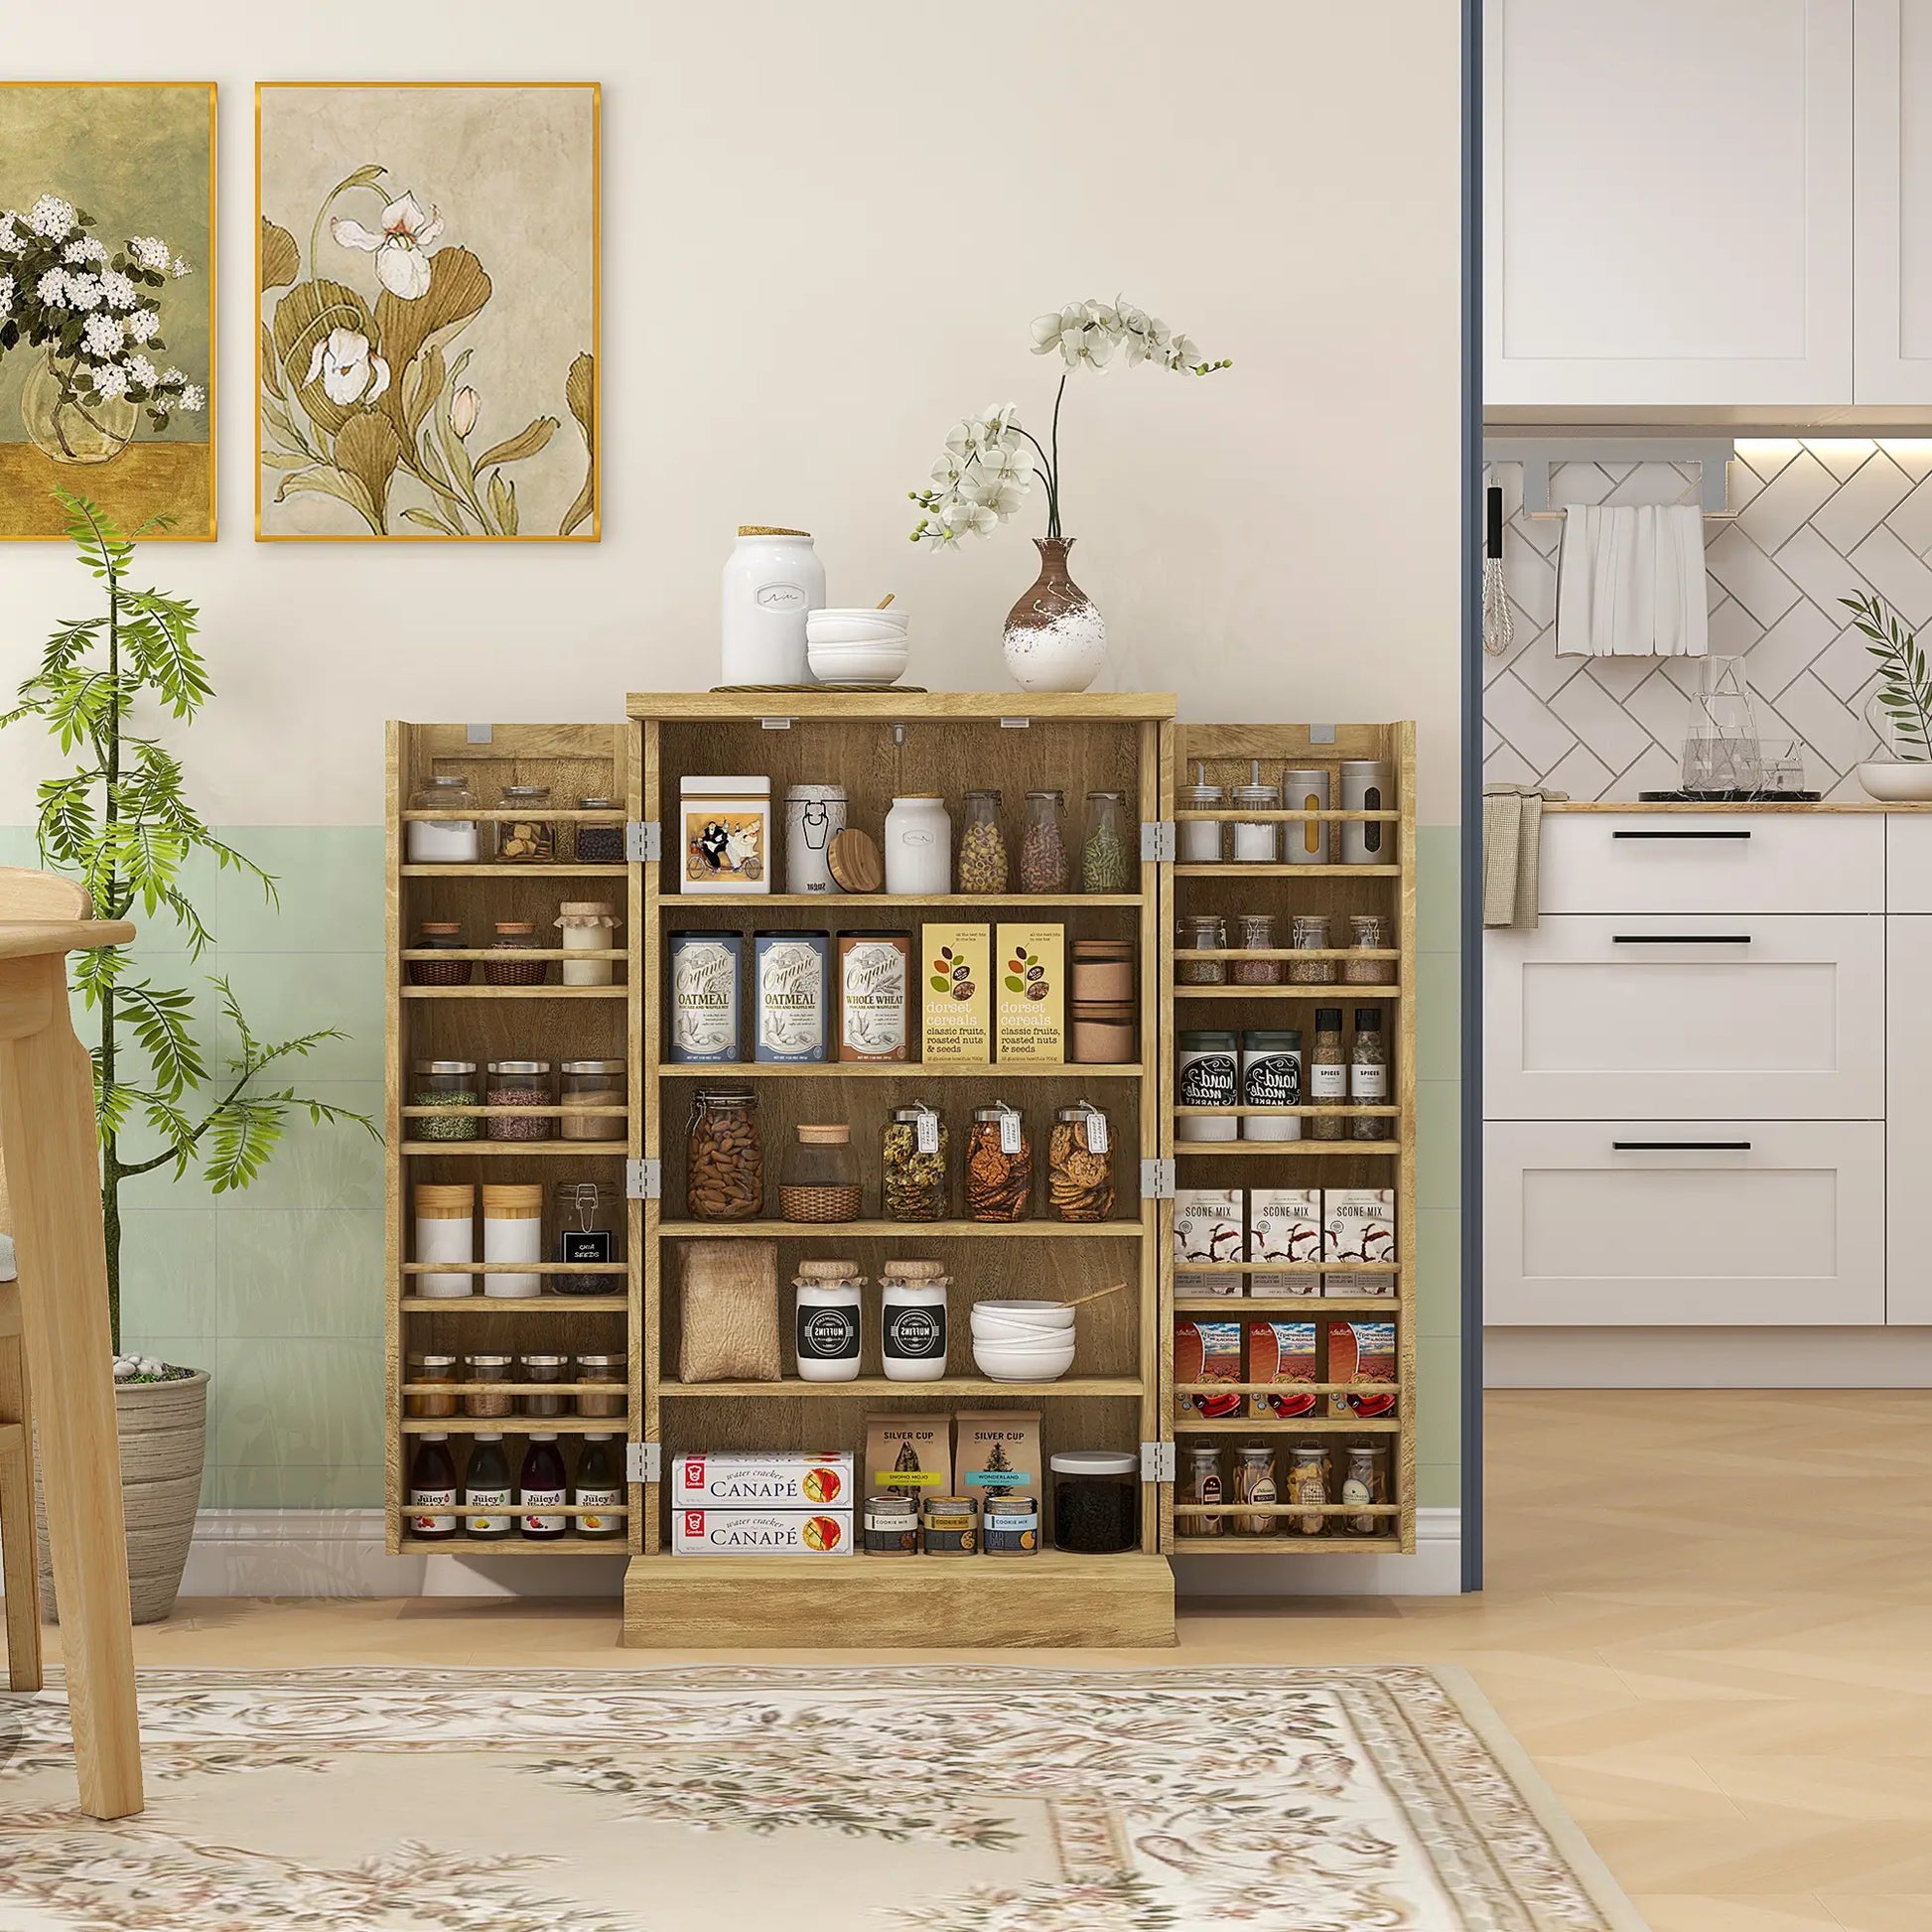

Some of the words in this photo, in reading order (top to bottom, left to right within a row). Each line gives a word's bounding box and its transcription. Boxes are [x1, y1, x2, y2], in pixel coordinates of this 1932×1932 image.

[676, 955, 728, 992] Organic
[762, 955, 814, 992] Organic
[846, 955, 897, 992] Organic
[678, 993, 730, 1005] OATMEAL
[764, 993, 816, 1005] OATMEAL
[846, 995, 874, 1005] WHOLE
[876, 995, 903, 1005] WHEAT
[926, 1002, 972, 1014] dorset
[1001, 1002, 1046, 1014] dorset
[926, 1014, 978, 1026] cereals
[1001, 1014, 1051, 1026] cereals
[926, 1027, 958, 1035] classic
[958, 1027, 987, 1036] fruits,
[1001, 1027, 1032, 1035] classic
[1033, 1027, 1060, 1036] fruits,
[1185, 1206, 1212, 1217] SCONE
[1216, 1206, 1232, 1217] MIX
[1263, 1206, 1291, 1217] SCONE
[1293, 1206, 1310, 1217] MIX
[1336, 1206, 1364, 1217] SCONE
[1367, 1206, 1383, 1217] MIX
[884, 1432, 913, 1441] SILVER
[915, 1432, 934, 1441] CUP
[974, 1432, 1004, 1441] SILVER
[1007, 1432, 1025, 1441] CUP
[726, 1469, 752, 1481] water
[753, 1468, 784, 1480] cracker
[710, 1478, 798, 1497] CANAPÉ
[417, 1494, 444, 1504] Juicy
[473, 1494, 499, 1504] Juicy
[527, 1494, 555, 1504] Juicy
[583, 1494, 610, 1504] Juicy
[726, 1518, 752, 1529] water
[753, 1516, 784, 1528] cracker
[710, 1527, 798, 1546] CANAPÉ
